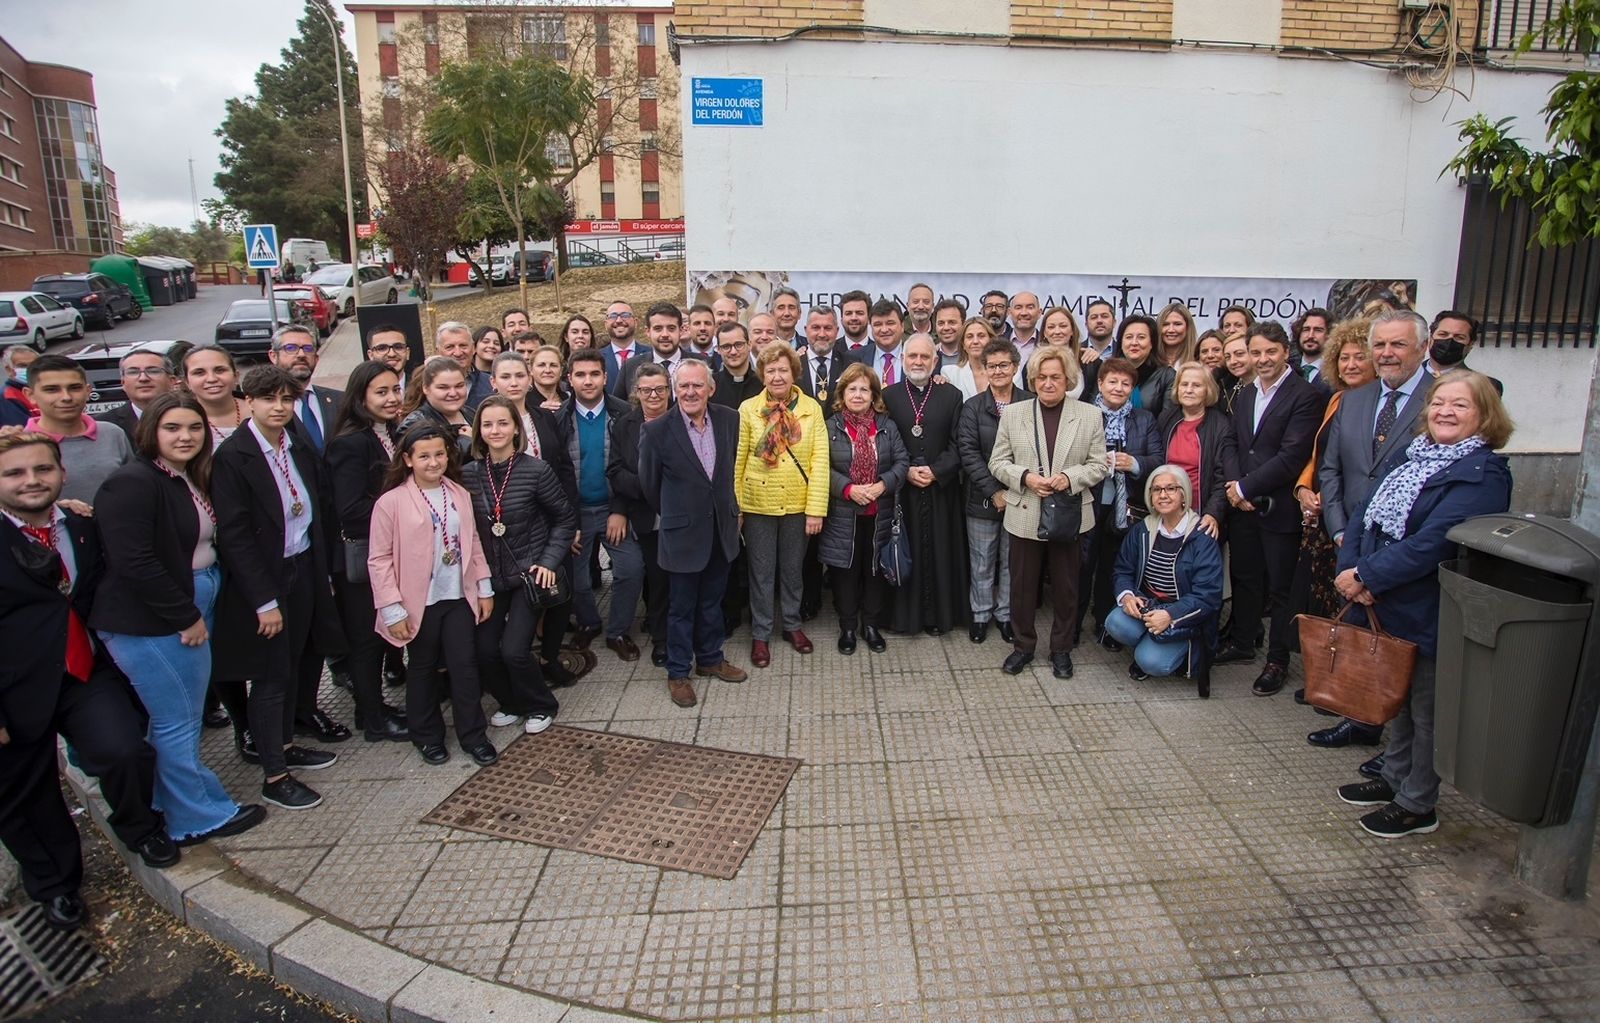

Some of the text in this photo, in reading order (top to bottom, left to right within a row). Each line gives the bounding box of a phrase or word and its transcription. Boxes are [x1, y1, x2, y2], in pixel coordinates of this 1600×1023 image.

[695, 97, 760, 108] VIRGEN DOLORES
[695, 108, 743, 119] DEL PERDÓN
[639, 222, 659, 231] súper
